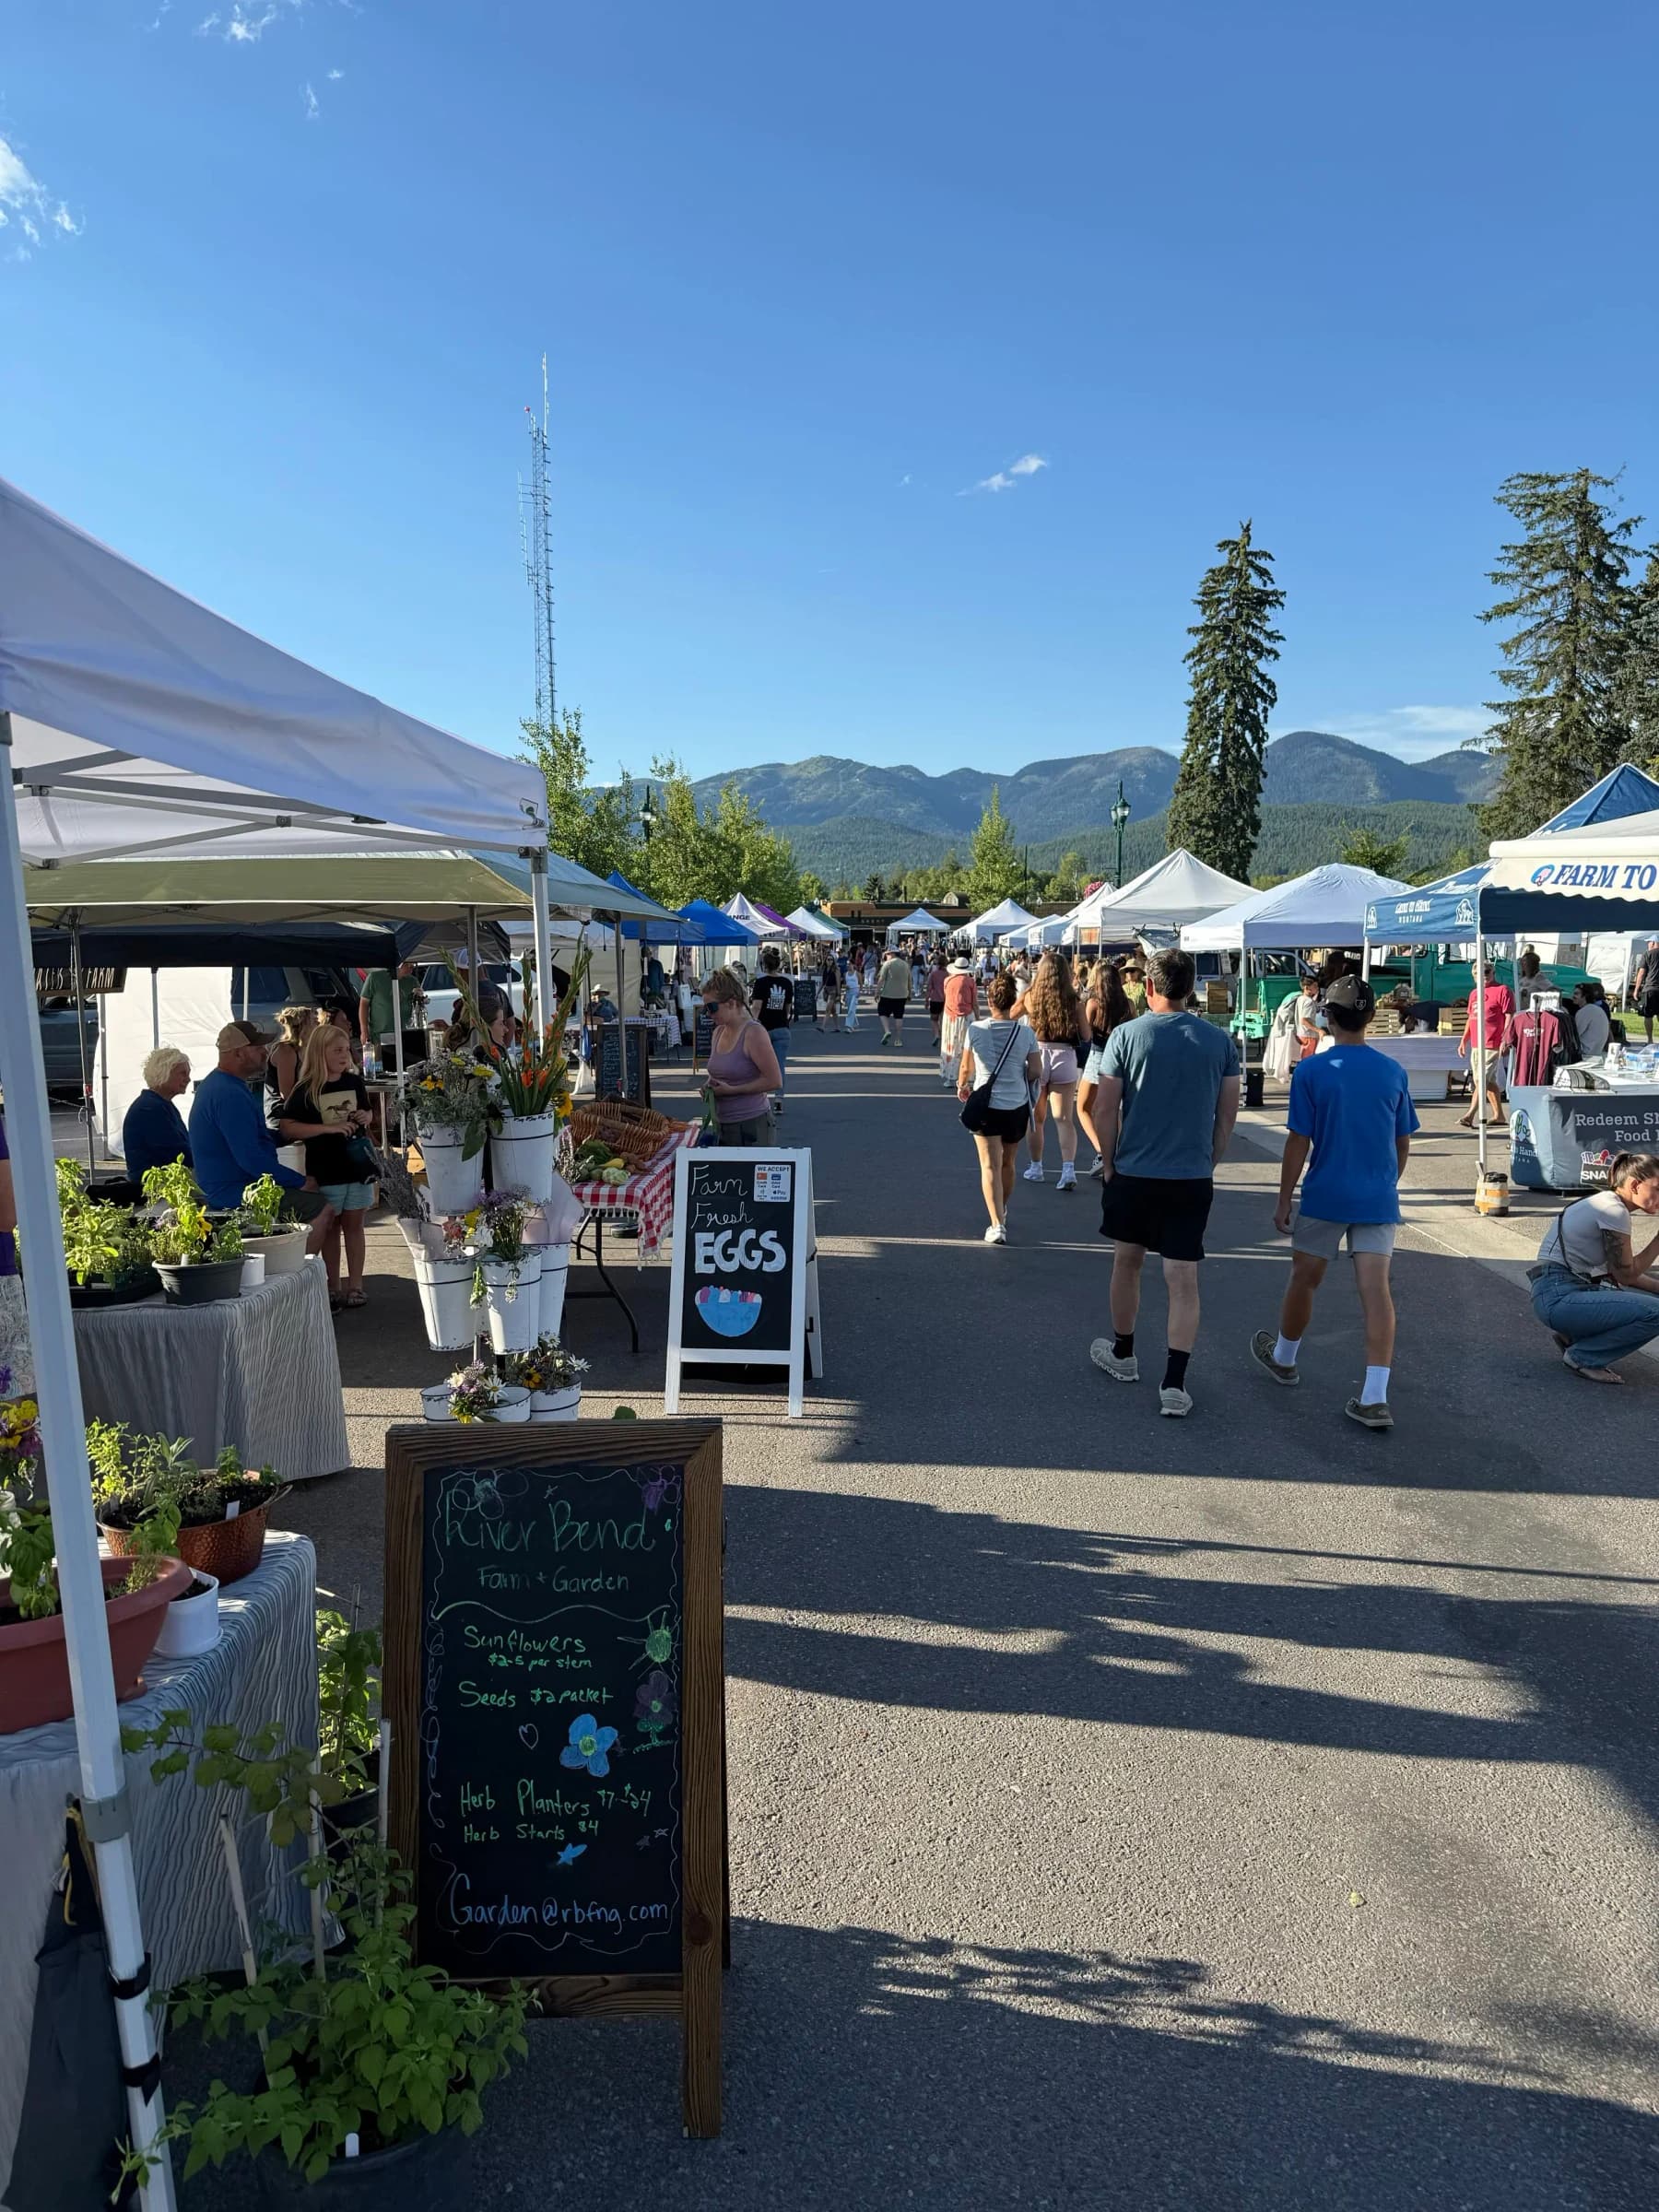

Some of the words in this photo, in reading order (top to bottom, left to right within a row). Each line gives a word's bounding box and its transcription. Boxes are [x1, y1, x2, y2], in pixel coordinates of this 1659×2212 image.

[1550, 865, 1619, 888] FARM
[1621, 864, 1657, 890] TO
[1575, 1112, 1639, 1126] Redeem
[1614, 1129, 1651, 1142] Food
[691, 1164, 747, 1196] Farm
[1581, 1170, 1610, 1181] SNA
[690, 1202, 753, 1230] Fresh
[695, 1229, 787, 1274] EGGS
[445, 1490, 537, 1552] River
[549, 1500, 656, 1552] Bend
[477, 1564, 530, 1590] Farm
[552, 1565, 629, 1592] Garden
[464, 1625, 586, 1653] Sunflowers
[528, 1658, 550, 1672] per
[556, 1654, 593, 1670] stem
[459, 1680, 516, 1707] Seeds
[460, 1783, 496, 1818] Herb
[517, 1779, 590, 1817] Planters
[464, 1825, 500, 1843] Herb
[516, 1823, 565, 1841] Starts
